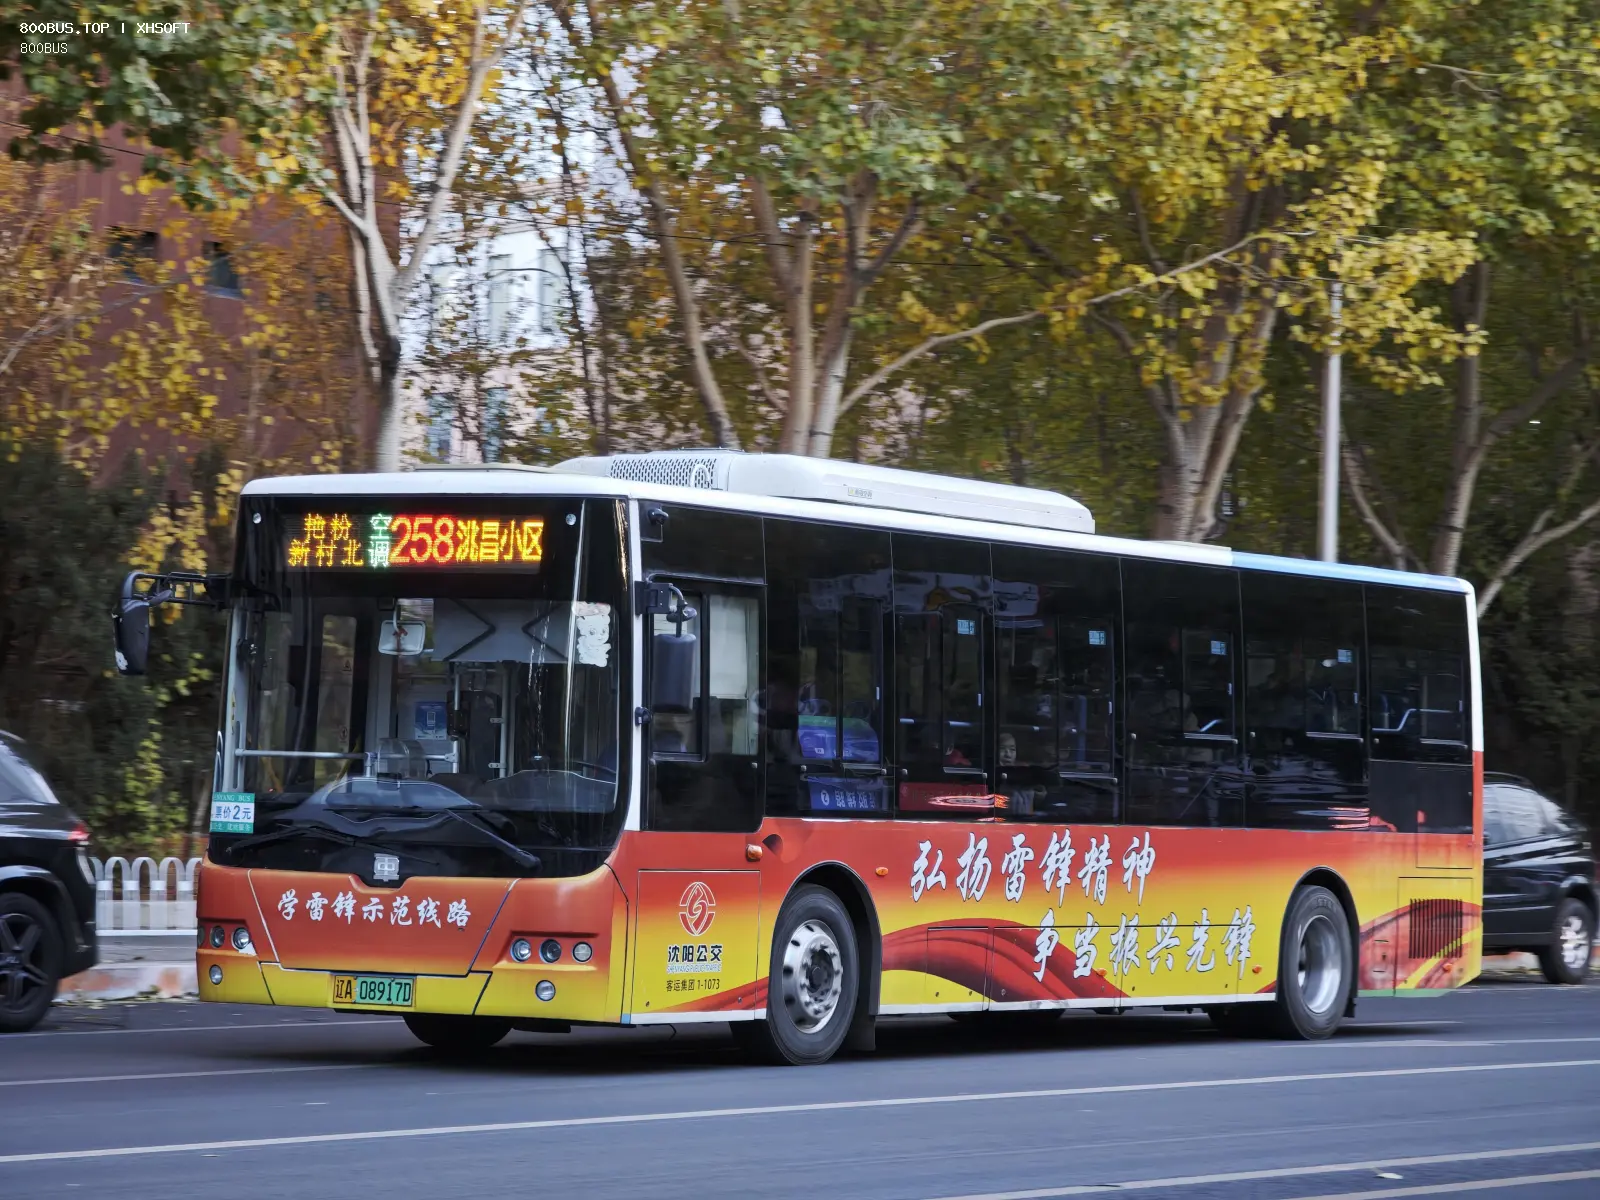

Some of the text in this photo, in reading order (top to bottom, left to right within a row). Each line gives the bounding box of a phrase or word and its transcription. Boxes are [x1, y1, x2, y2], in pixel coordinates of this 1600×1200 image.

[288, 539, 364, 567] 新村北
[368, 513, 392, 567] 空调
[391, 516, 455, 564] 258
[456, 519, 544, 562] 洮昌小区
[215, 805, 251, 820] 票价2元
[910, 828, 1156, 908] 弘扬雷锋精神
[277, 888, 471, 929] 学雷锋示范线路
[668, 944, 722, 963] 沈阳公交
[1033, 904, 1256, 983] 争当振兴先锋
[666, 978, 720, 992] 客运集团 1-1073
